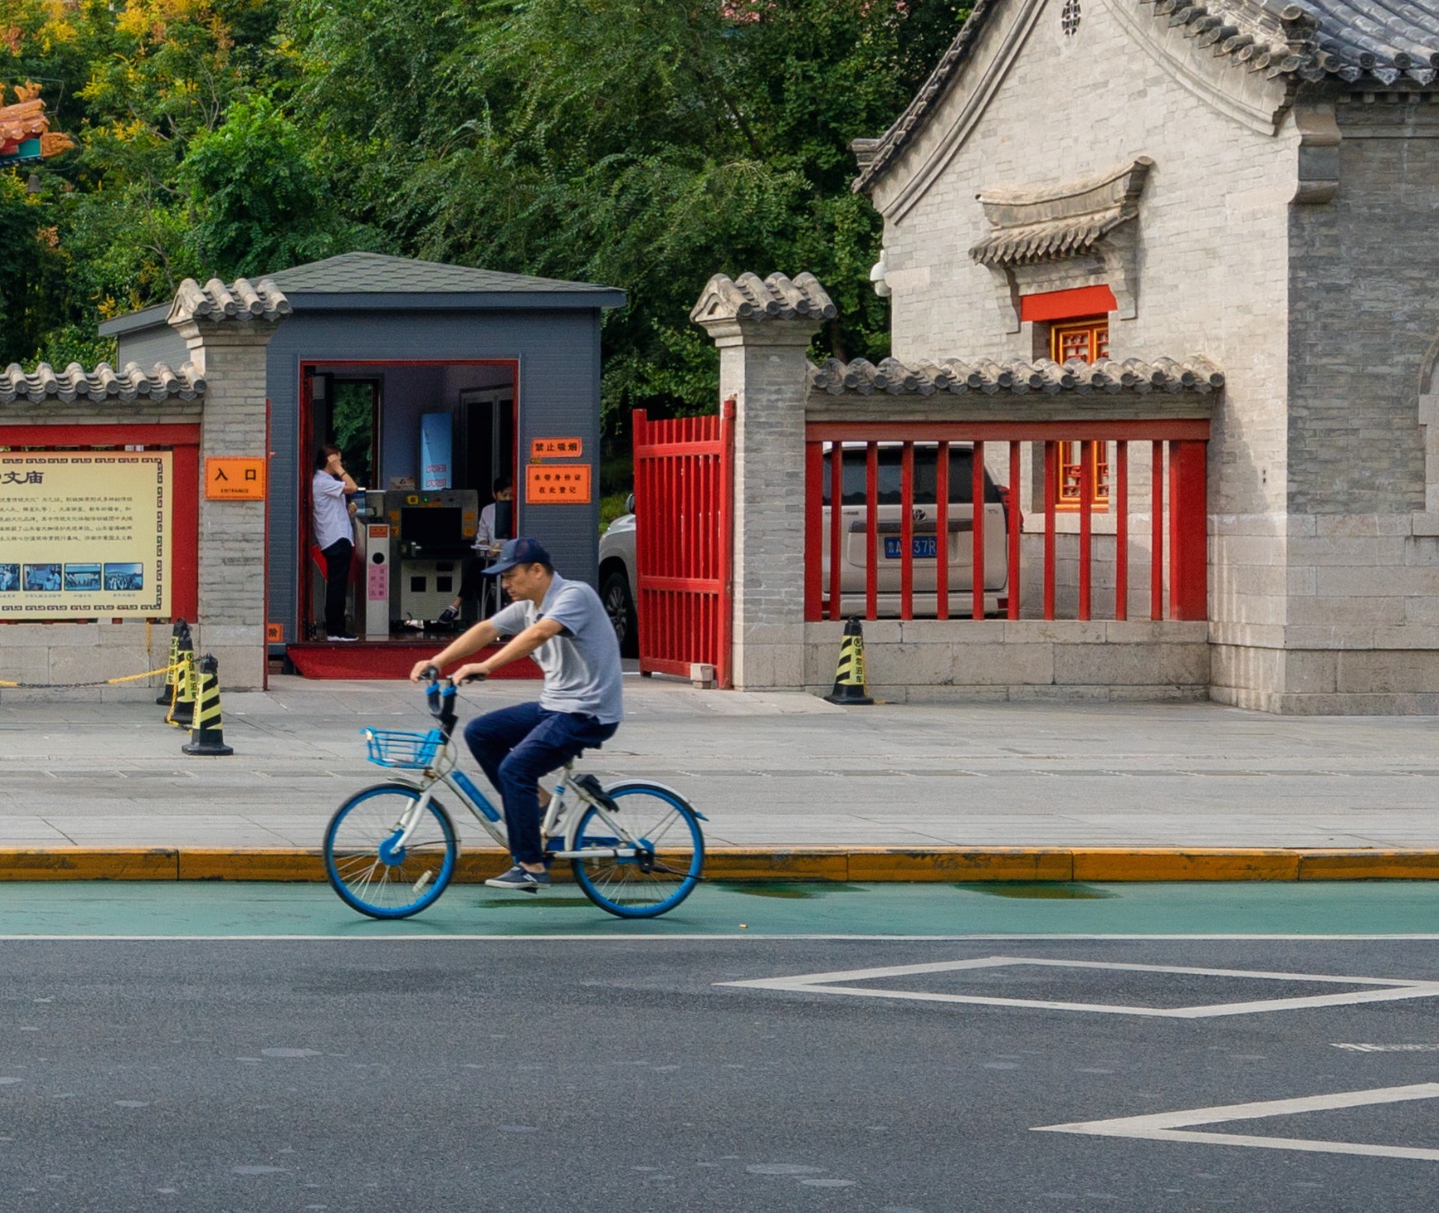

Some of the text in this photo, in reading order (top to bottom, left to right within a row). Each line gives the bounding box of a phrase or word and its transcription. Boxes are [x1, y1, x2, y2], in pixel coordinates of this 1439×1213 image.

[535, 442, 578, 452] 禁止吸烟
[214, 467, 257, 481] 入口
